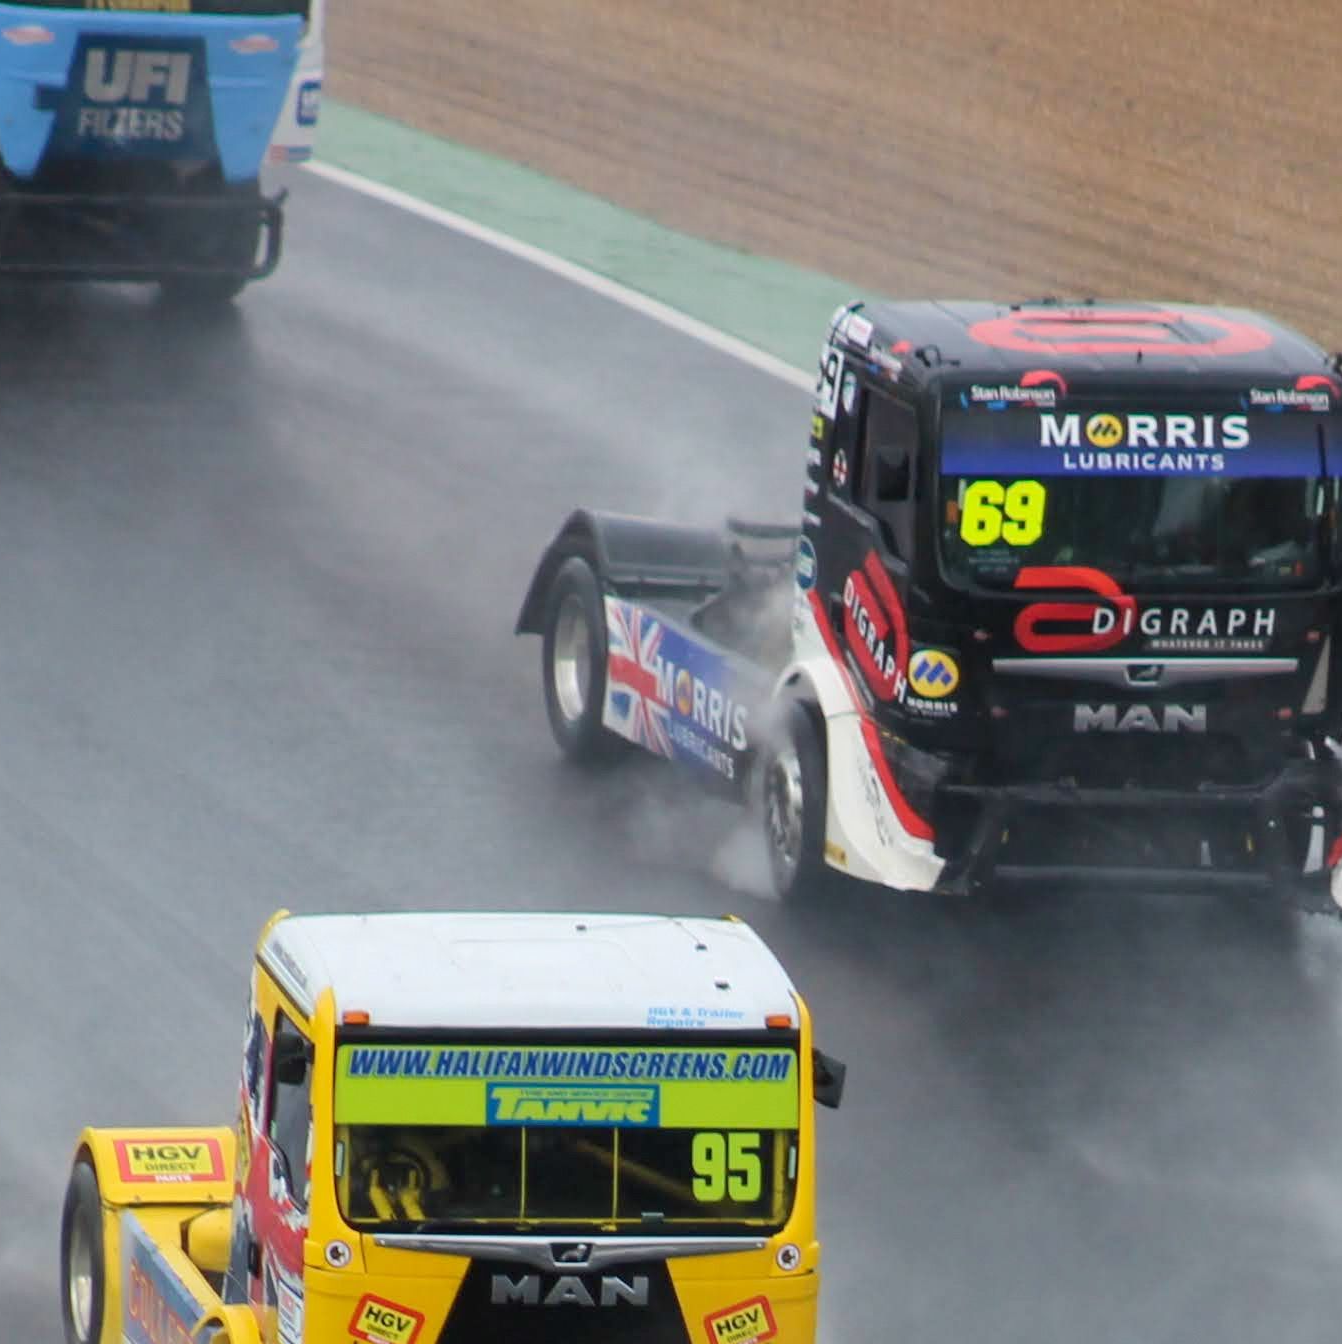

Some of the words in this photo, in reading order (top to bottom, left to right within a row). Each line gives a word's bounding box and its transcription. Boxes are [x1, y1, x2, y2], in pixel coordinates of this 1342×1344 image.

[83, 48, 193, 105] UFI
[971, 384, 999, 401] Stan
[1000, 385, 1056, 402] Robinson
[1249, 389, 1275, 403] Stan
[1276, 390, 1329, 405] Robinson
[1040, 413, 1251, 448] MORRIS
[1063, 452, 1226, 471] LUBRICANTS
[959, 480, 1046, 547] 69
[1091, 608, 1276, 636] DIGRAPH
[843, 576, 907, 703] DIGRAPH
[657, 655, 749, 752] MORRIS
[1073, 703, 1207, 732] MAN
[349, 1048, 793, 1081] WWW.HALIFAXWINDSCREENS.COM
[131, 1145, 202, 1161] HGV
[144, 1162, 197, 1172] DIRECT
[691, 1132, 762, 1203] 95
[490, 1275, 650, 1307] MAN
[364, 1305, 412, 1333] HGV
[715, 1306, 760, 1337] HGV
